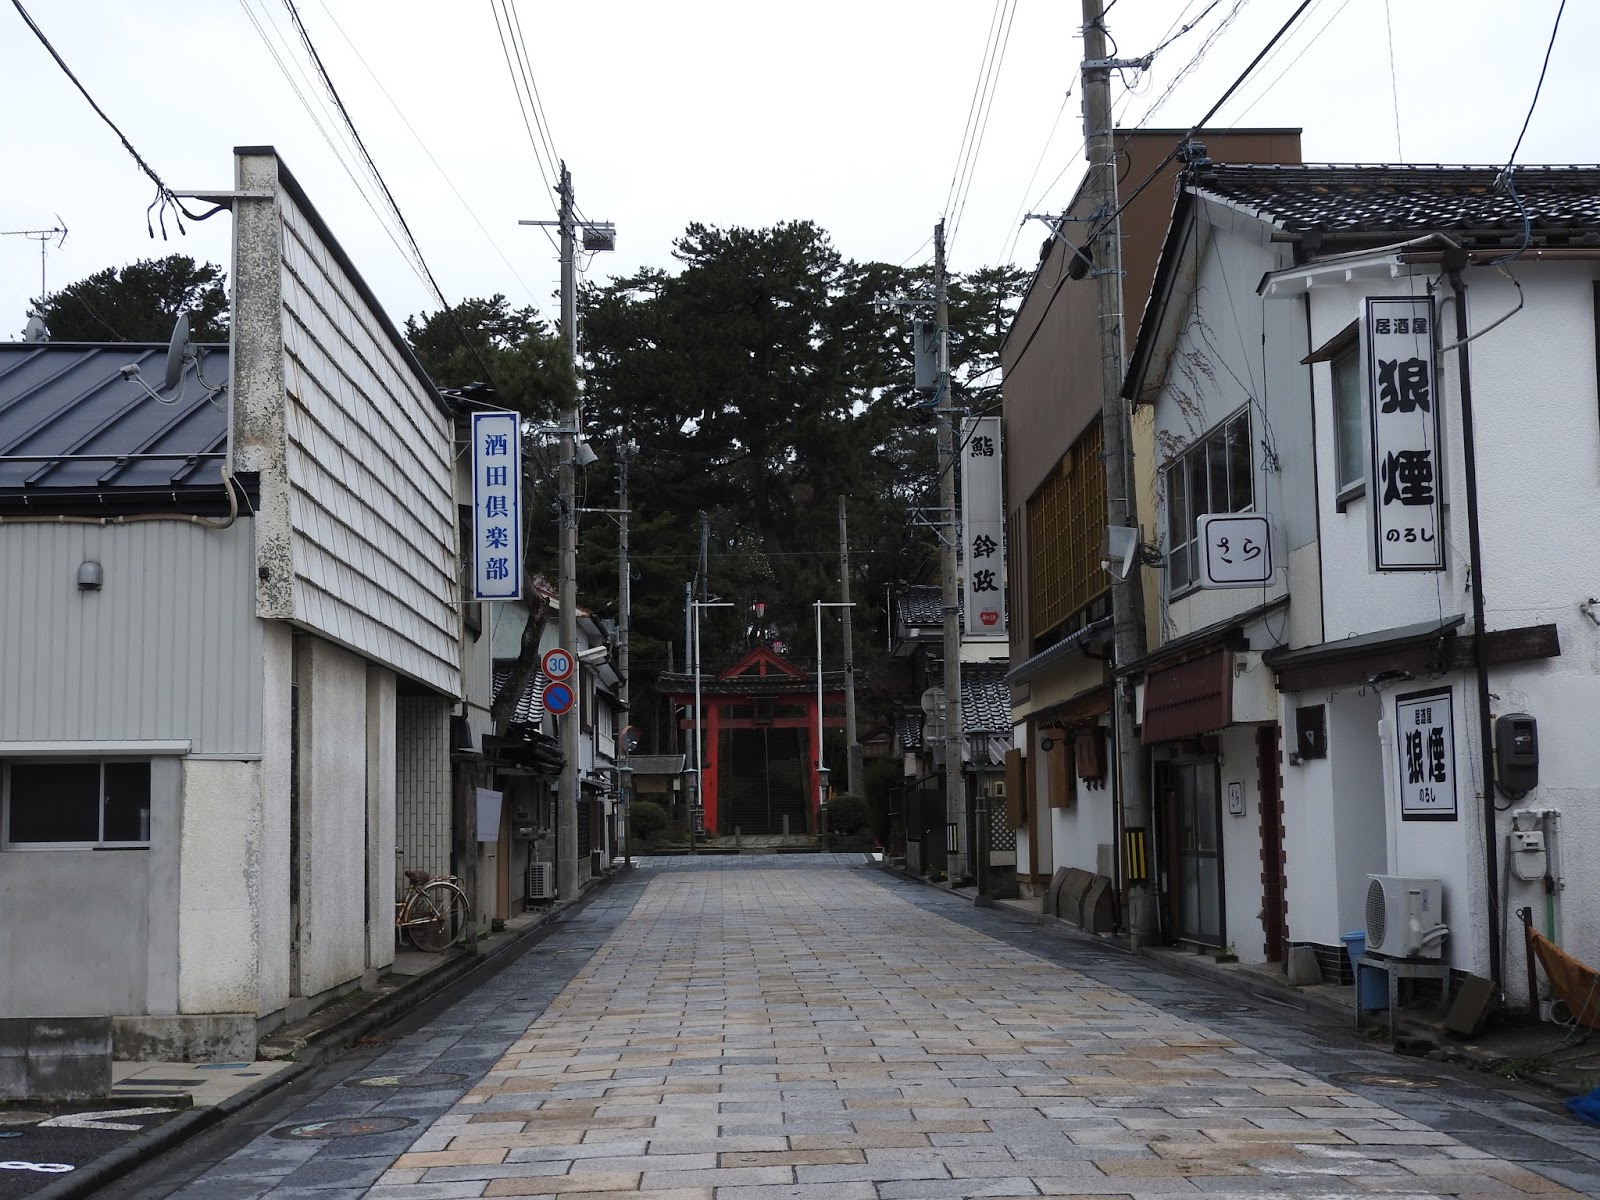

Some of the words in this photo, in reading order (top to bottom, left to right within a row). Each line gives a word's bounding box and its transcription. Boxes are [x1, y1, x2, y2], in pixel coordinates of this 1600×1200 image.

[1375, 318, 1428, 335] 居酒屋
[1378, 357, 1434, 506] 狼煙
[971, 436, 994, 458] 鮨
[485, 434, 509, 580] 酒田倶楽部
[1386, 527, 1435, 543] のろし
[1216, 537, 1262, 564] さら
[972, 534, 999, 593] 鈴政
[549, 657, 567, 672] 30
[1405, 726, 1446, 784] 狼煙
[1419, 787, 1436, 803] のろし
